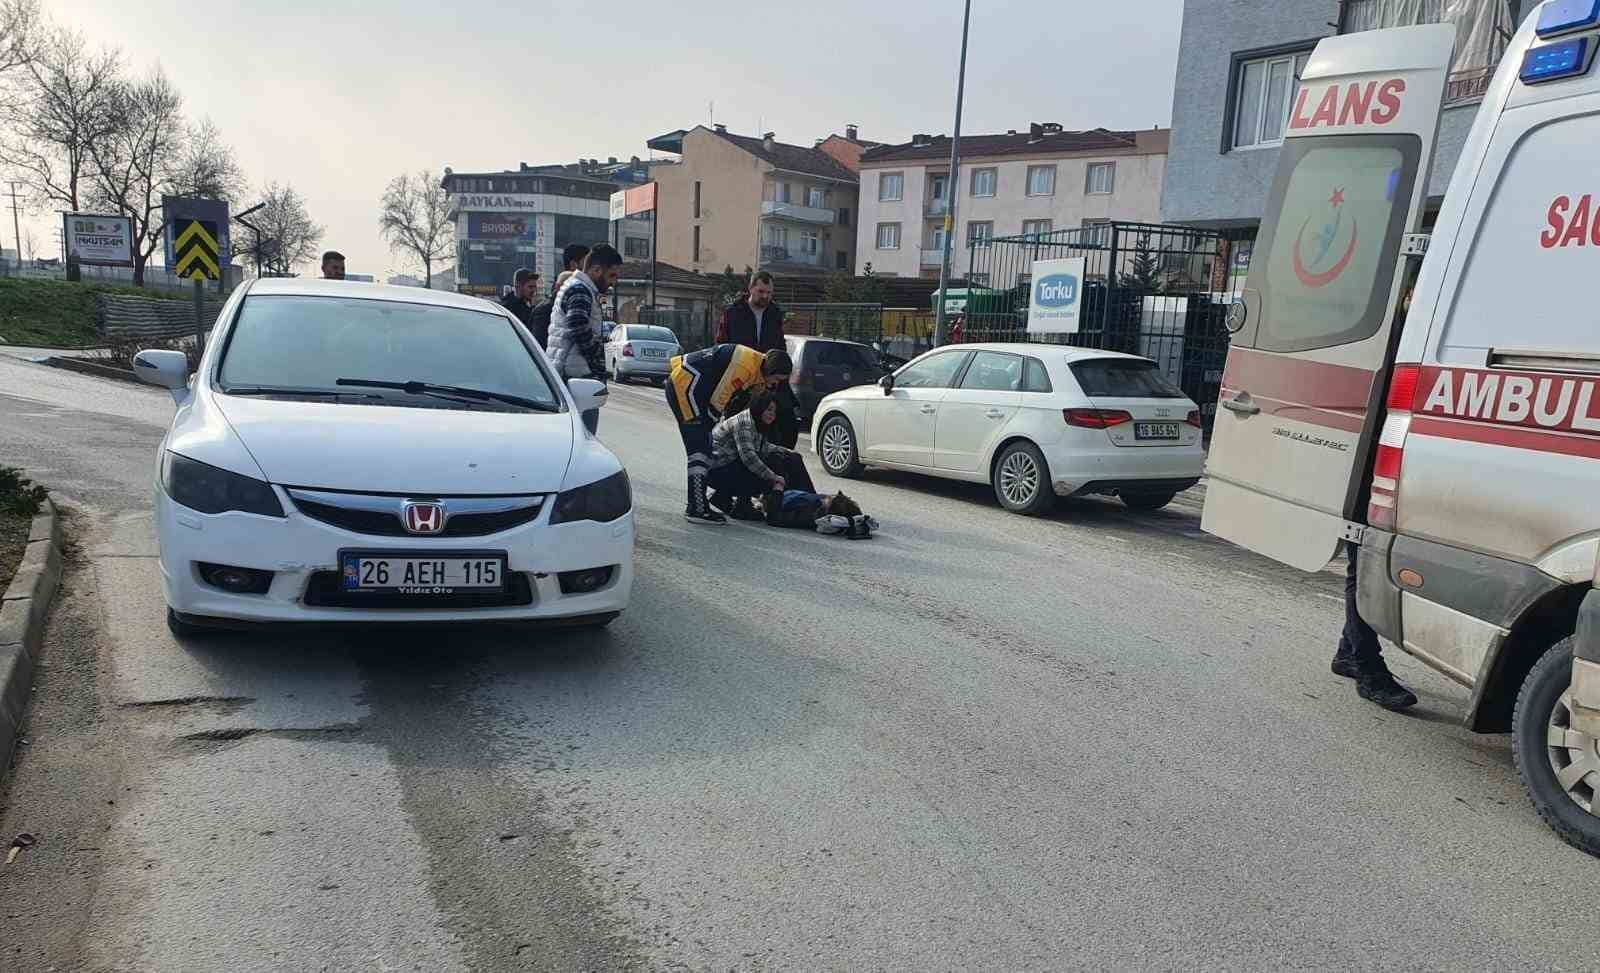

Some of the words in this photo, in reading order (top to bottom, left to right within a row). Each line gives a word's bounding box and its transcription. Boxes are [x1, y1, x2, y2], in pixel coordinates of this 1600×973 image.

[1290, 78, 1406, 129] LANS
[1040, 280, 1073, 300] Torku
[1422, 369, 1600, 432] AMBUL
[362, 560, 389, 585] 26
[403, 561, 445, 585] AEH
[463, 561, 497, 585] 115
[432, 587, 453, 595] Oto
